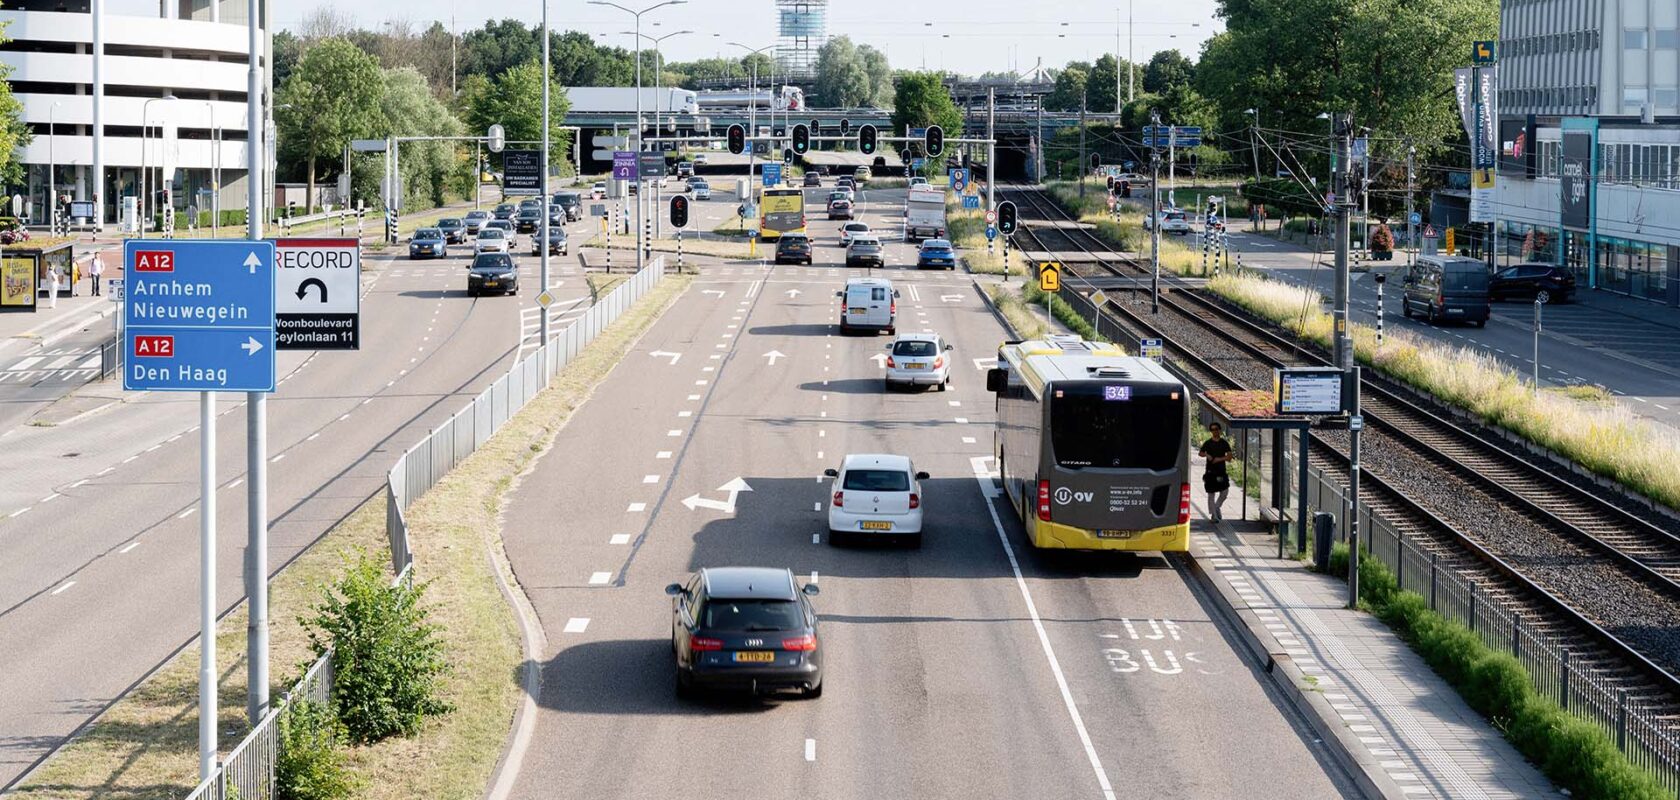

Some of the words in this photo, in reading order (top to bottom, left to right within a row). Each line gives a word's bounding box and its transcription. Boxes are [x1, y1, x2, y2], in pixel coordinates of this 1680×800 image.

[1563, 161, 1582, 178] carpet
[1571, 178, 1586, 203] right
[134, 279, 212, 296] Arnhem
[1046, 274, 1054, 284] L
[134, 302, 248, 323] Nieuwegein
[341, 331, 353, 342] 11
[134, 364, 170, 380] Den
[179, 365, 227, 385] Haag
[1108, 386, 1126, 399] 34
